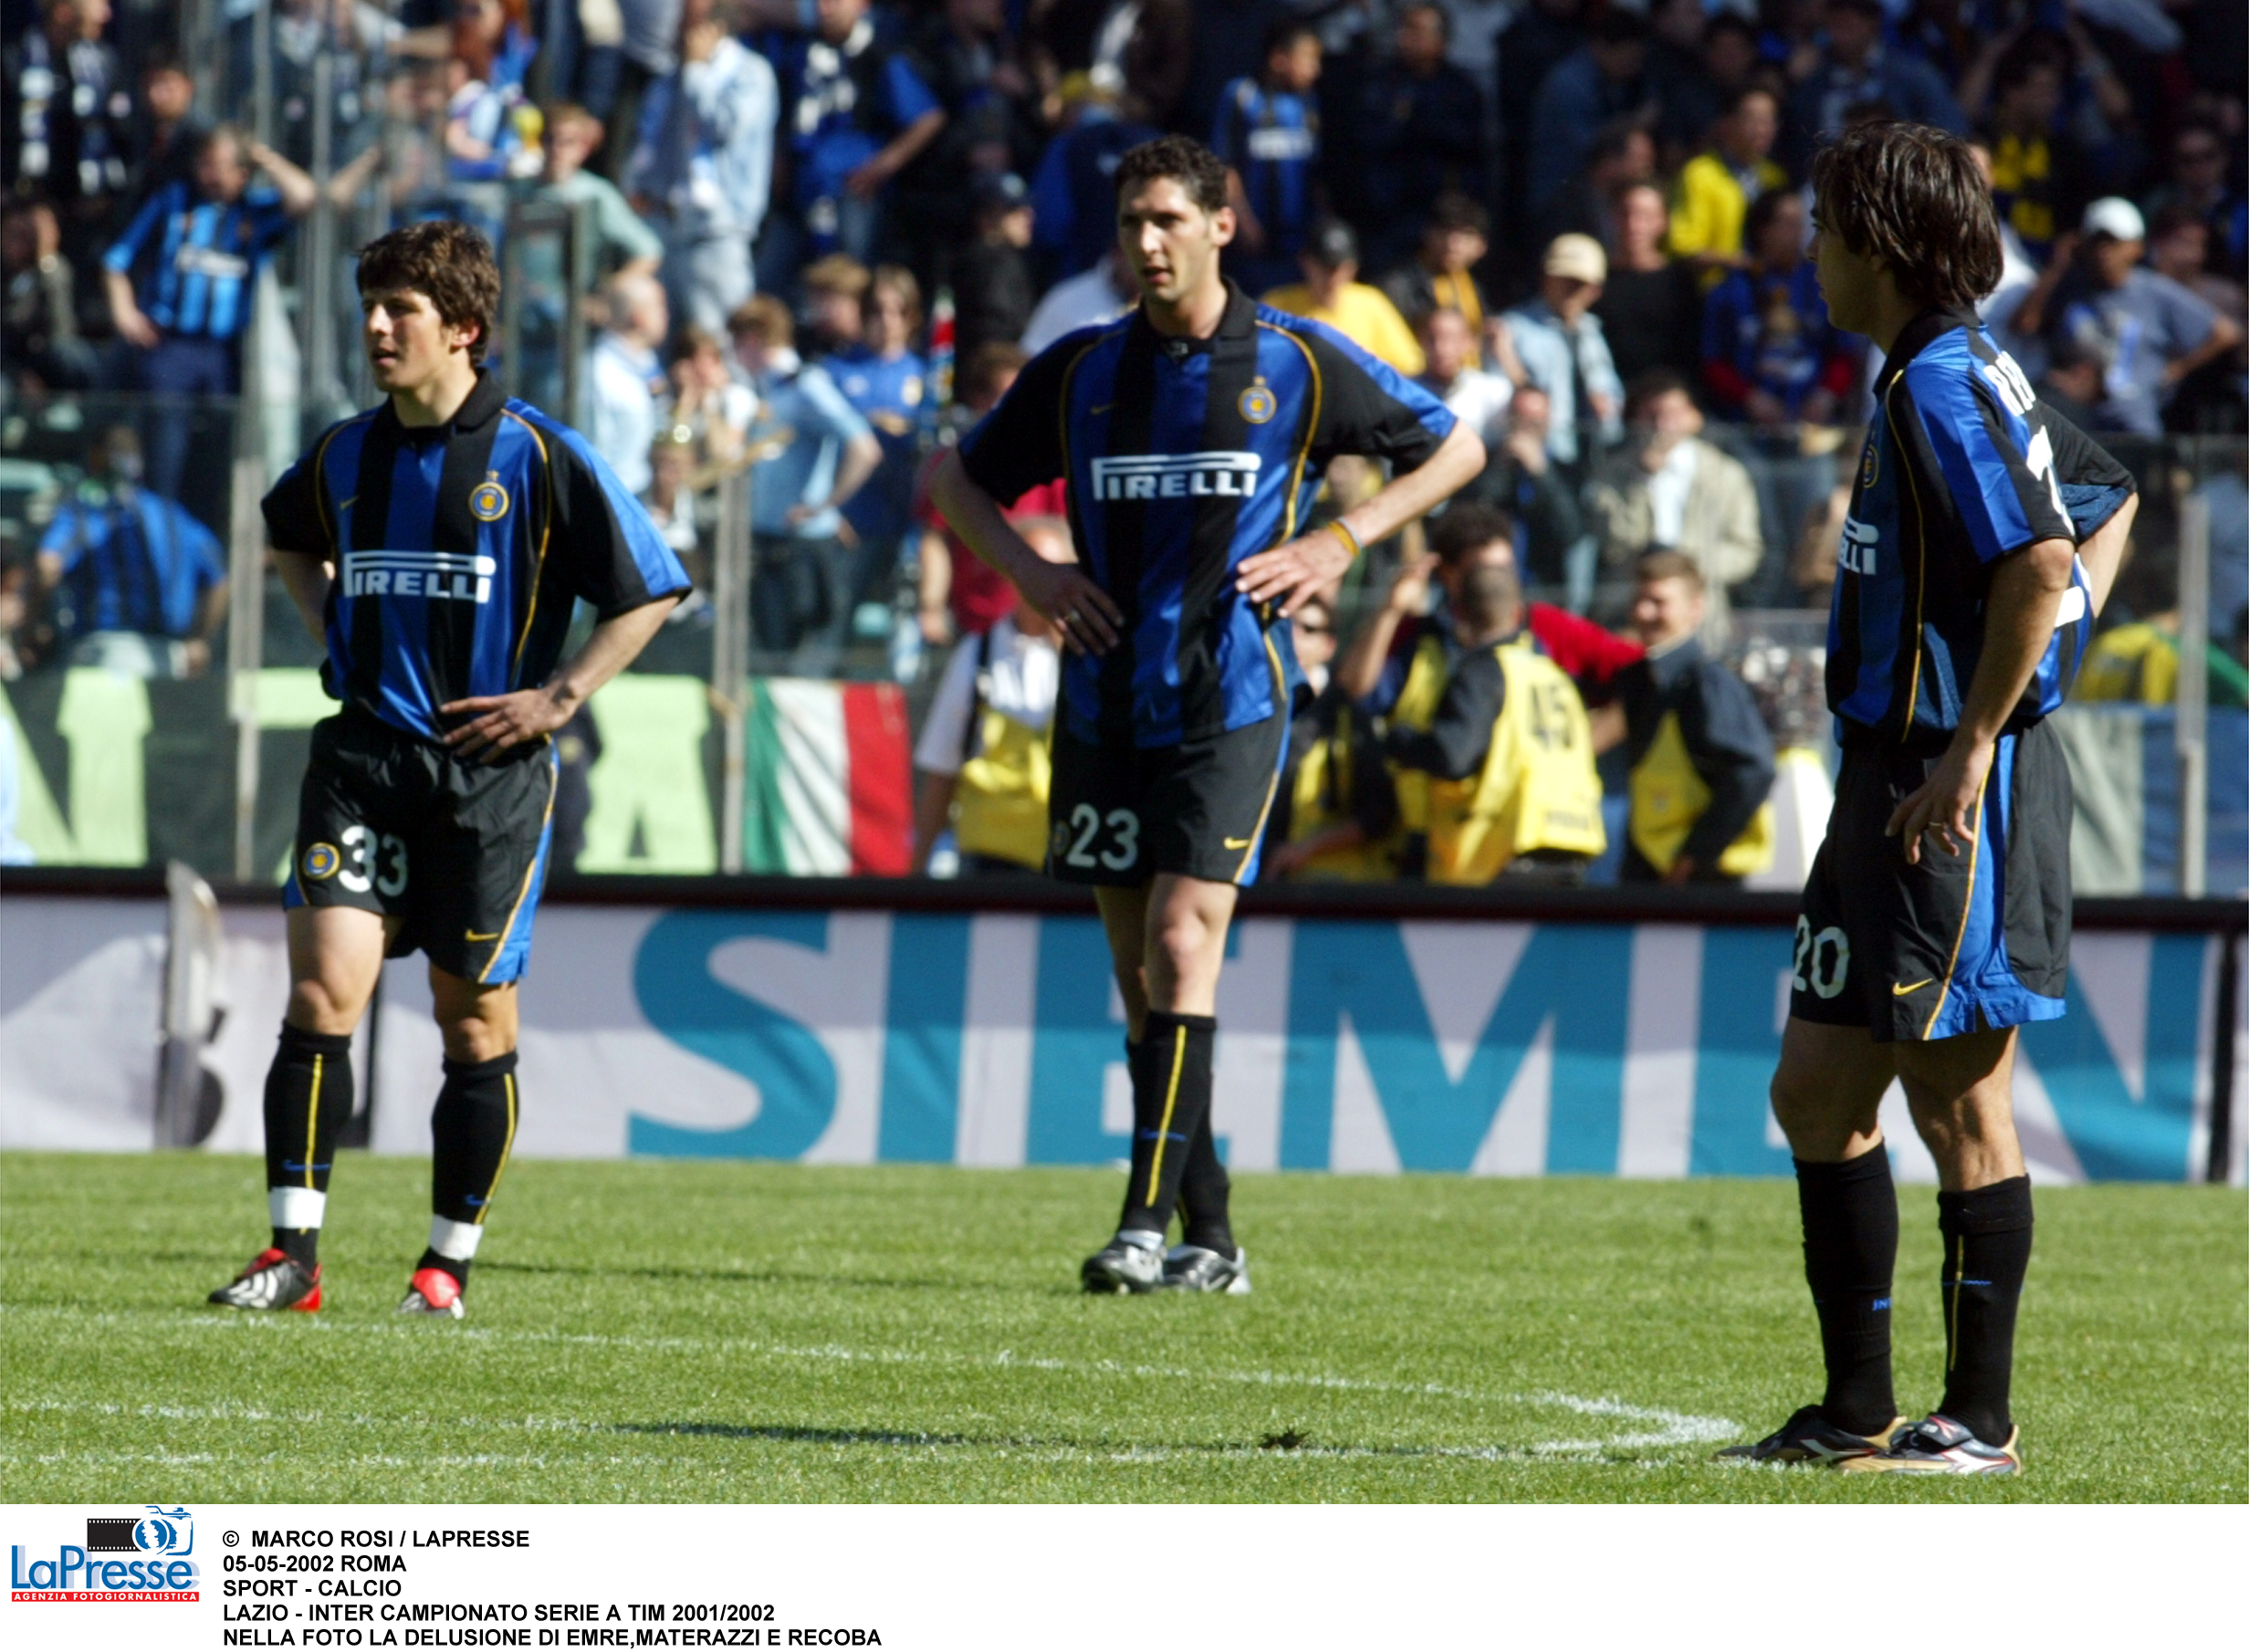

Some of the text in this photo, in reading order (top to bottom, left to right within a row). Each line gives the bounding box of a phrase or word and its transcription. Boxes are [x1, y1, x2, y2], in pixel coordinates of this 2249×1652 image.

[1091, 451, 1261, 500] PIRELLI
[343, 549, 497, 603] PIRELLI
[1527, 683, 1573, 749] 45
[338, 825, 409, 896] 33
[1066, 803, 1140, 872] 23
[1793, 914, 1850, 999] 20
